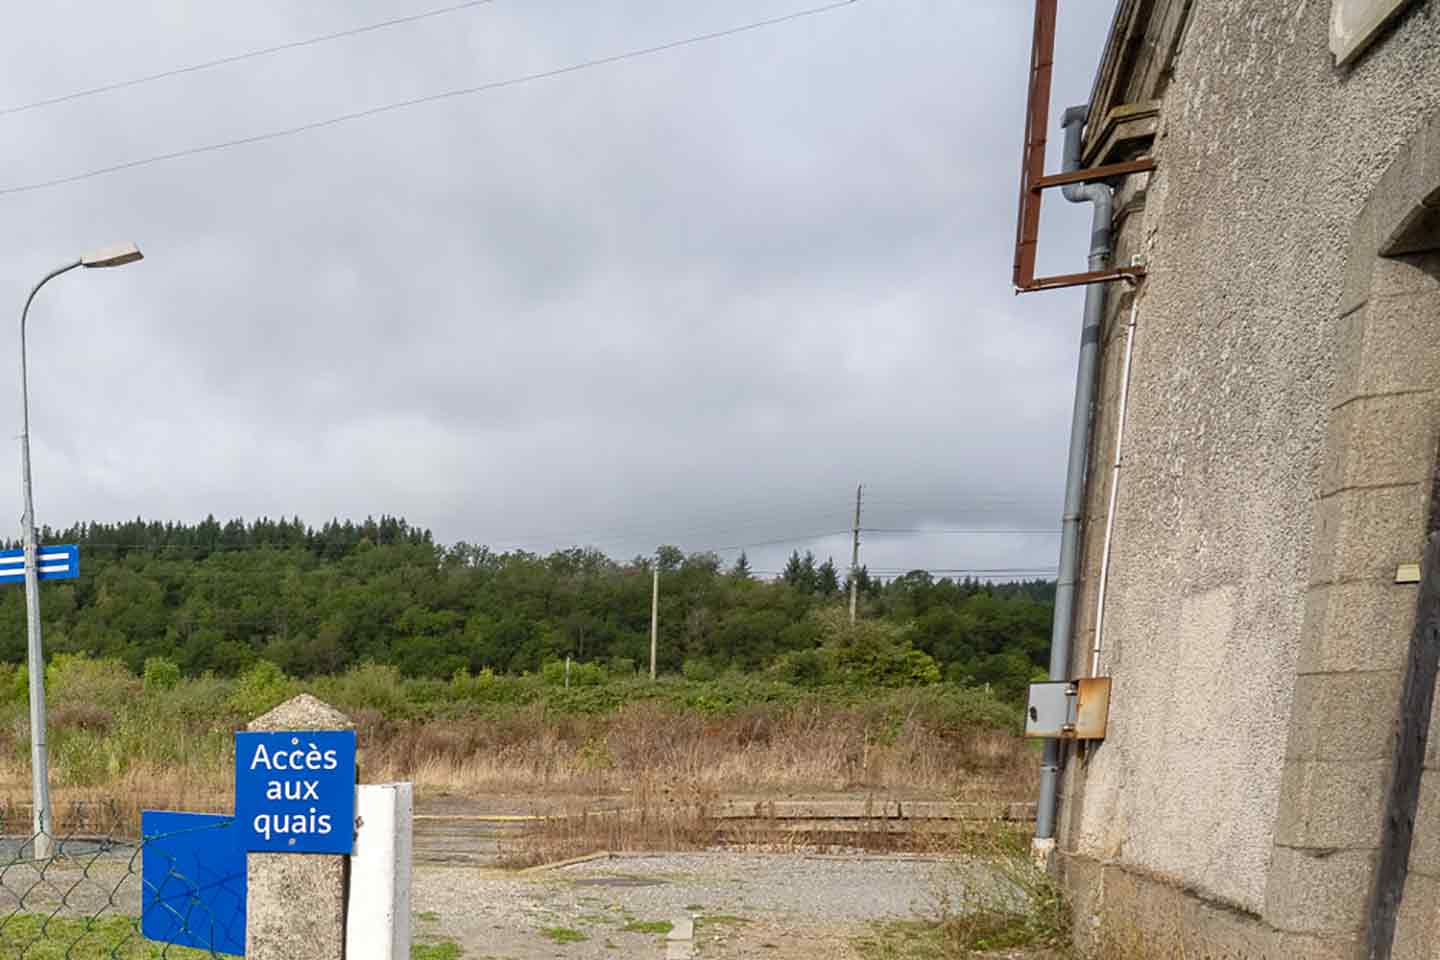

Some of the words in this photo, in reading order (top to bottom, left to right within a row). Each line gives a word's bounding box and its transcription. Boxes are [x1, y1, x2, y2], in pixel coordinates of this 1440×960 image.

[250, 743, 338, 770] Accès
[266, 780, 319, 800] aux
[253, 807, 332, 840] quais
